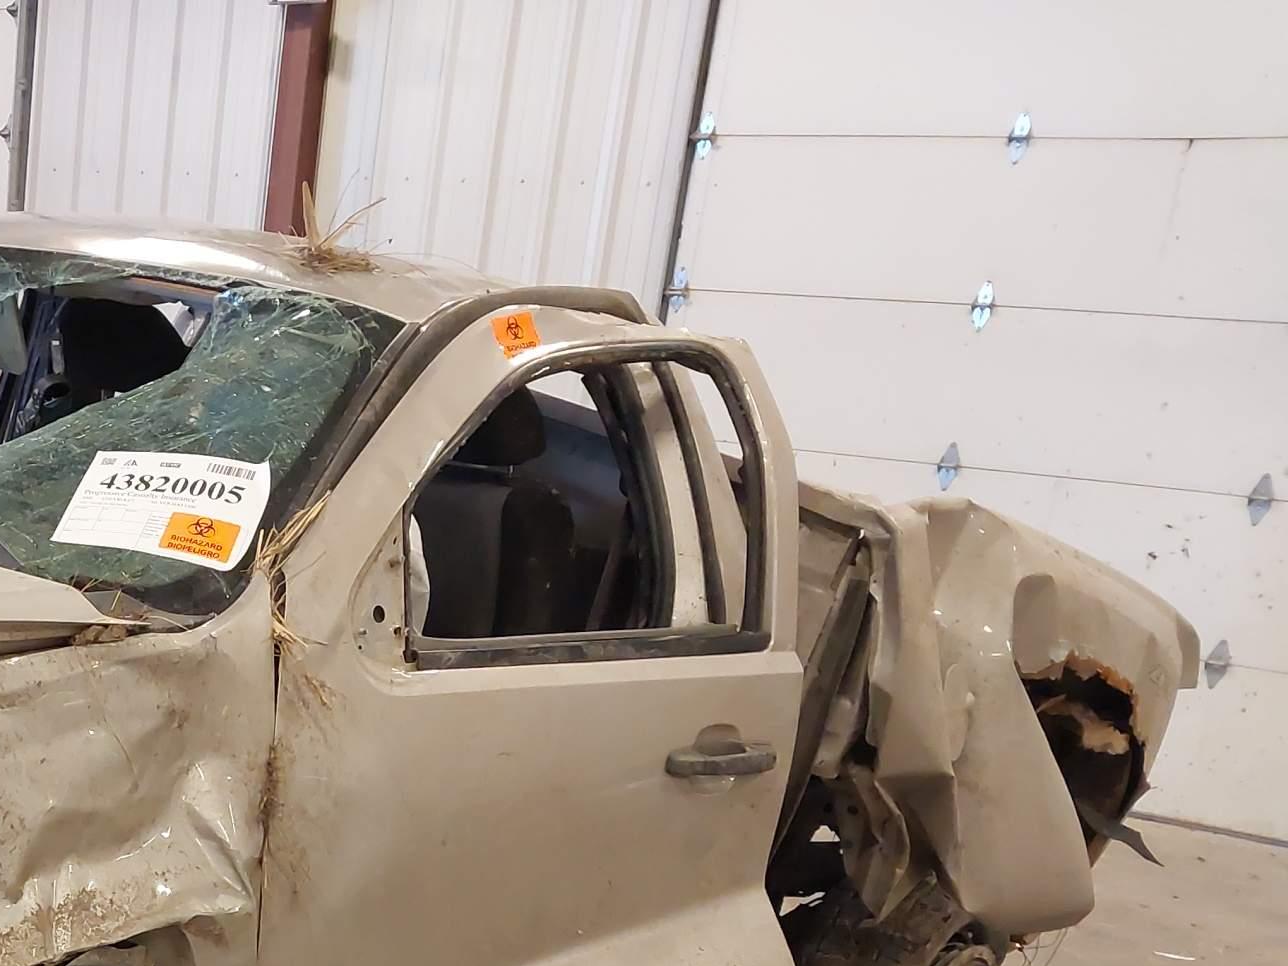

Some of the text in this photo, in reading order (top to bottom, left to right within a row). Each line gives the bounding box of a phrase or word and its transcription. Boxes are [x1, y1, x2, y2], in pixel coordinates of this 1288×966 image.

[100, 472, 247, 504] 43820005
[167, 541, 220, 559] BIOPELIGRO
[170, 534, 223, 551] BIOHAZARD
